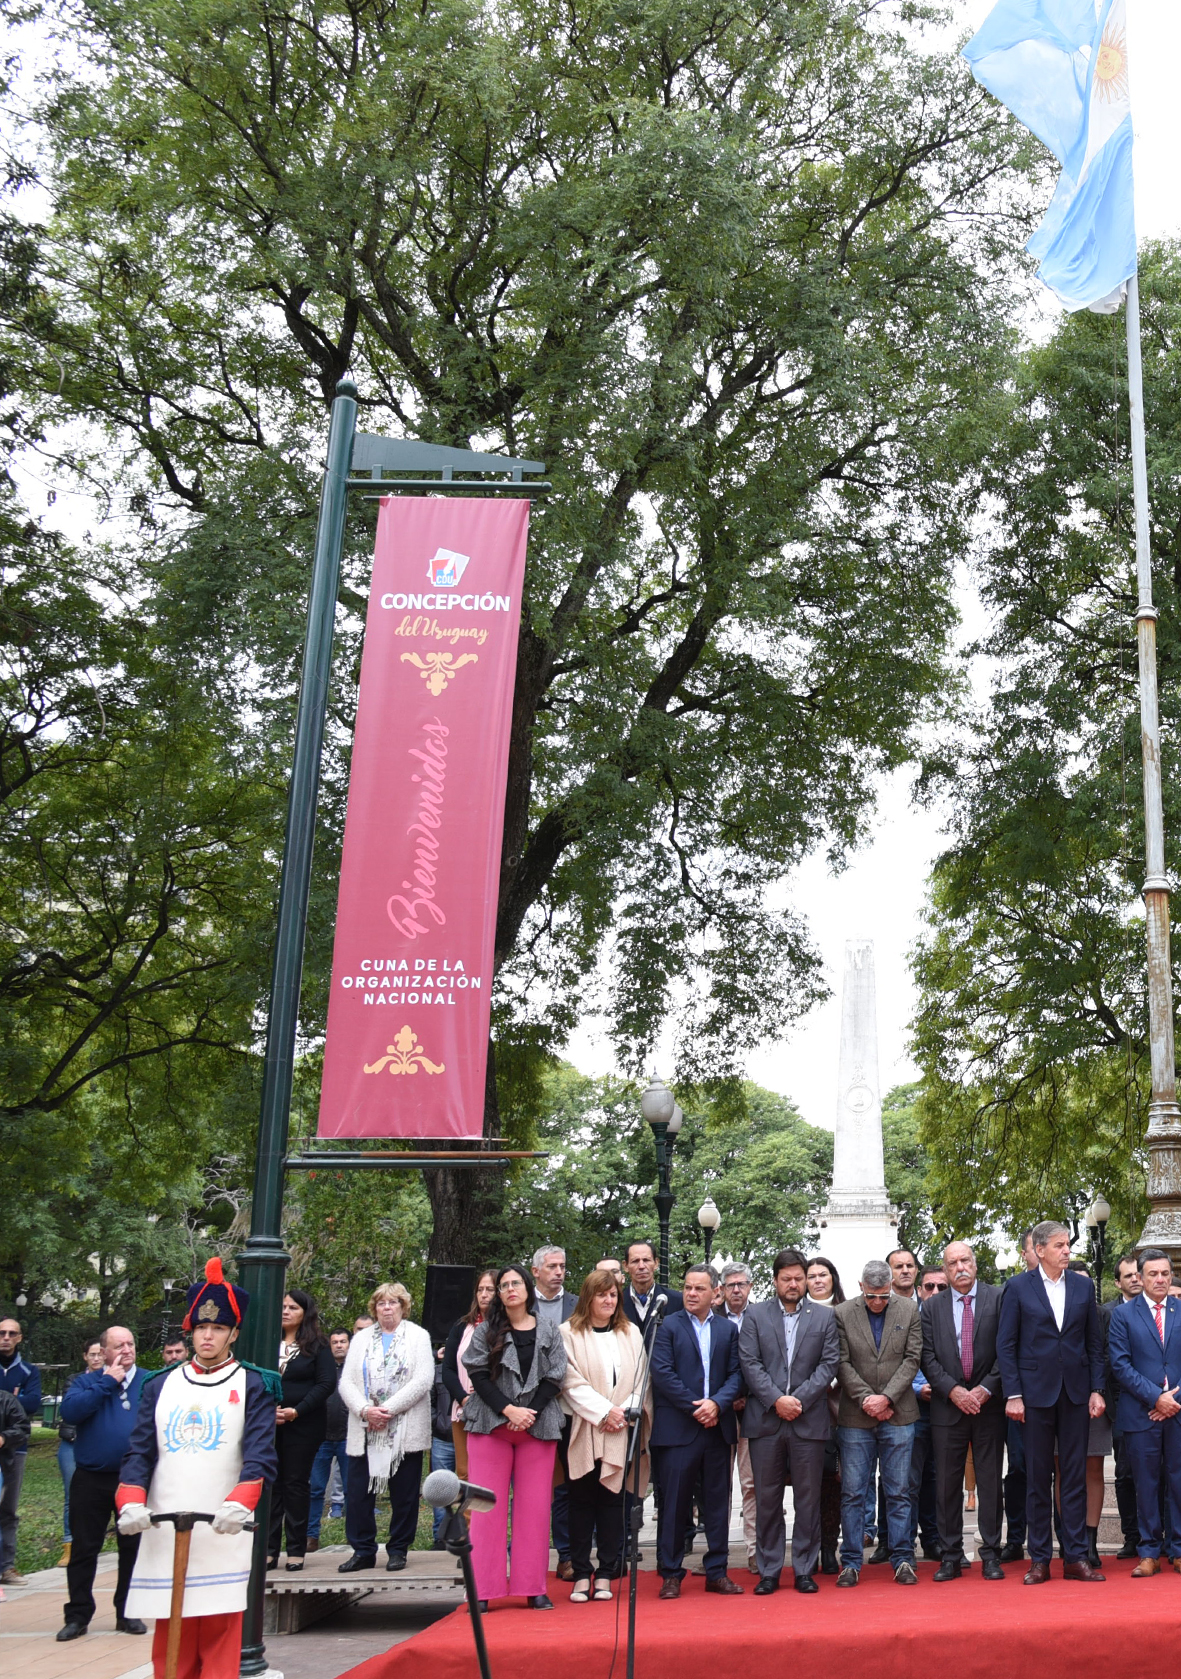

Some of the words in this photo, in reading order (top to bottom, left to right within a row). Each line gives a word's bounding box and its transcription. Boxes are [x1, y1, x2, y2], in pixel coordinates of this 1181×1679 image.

[436, 575, 453, 585] CDU
[381, 592, 510, 611] CONCEPCIÓN
[394, 615, 420, 637] del
[422, 617, 489, 645] Uruguay
[387, 716, 450, 939] Bienvenidos
[361, 959, 408, 971] CUNA
[415, 959, 437, 971] DE
[443, 959, 465, 972] LA
[341, 974, 481, 989] ORGANIZACIÓN
[364, 992, 456, 1004] NACIONAL
